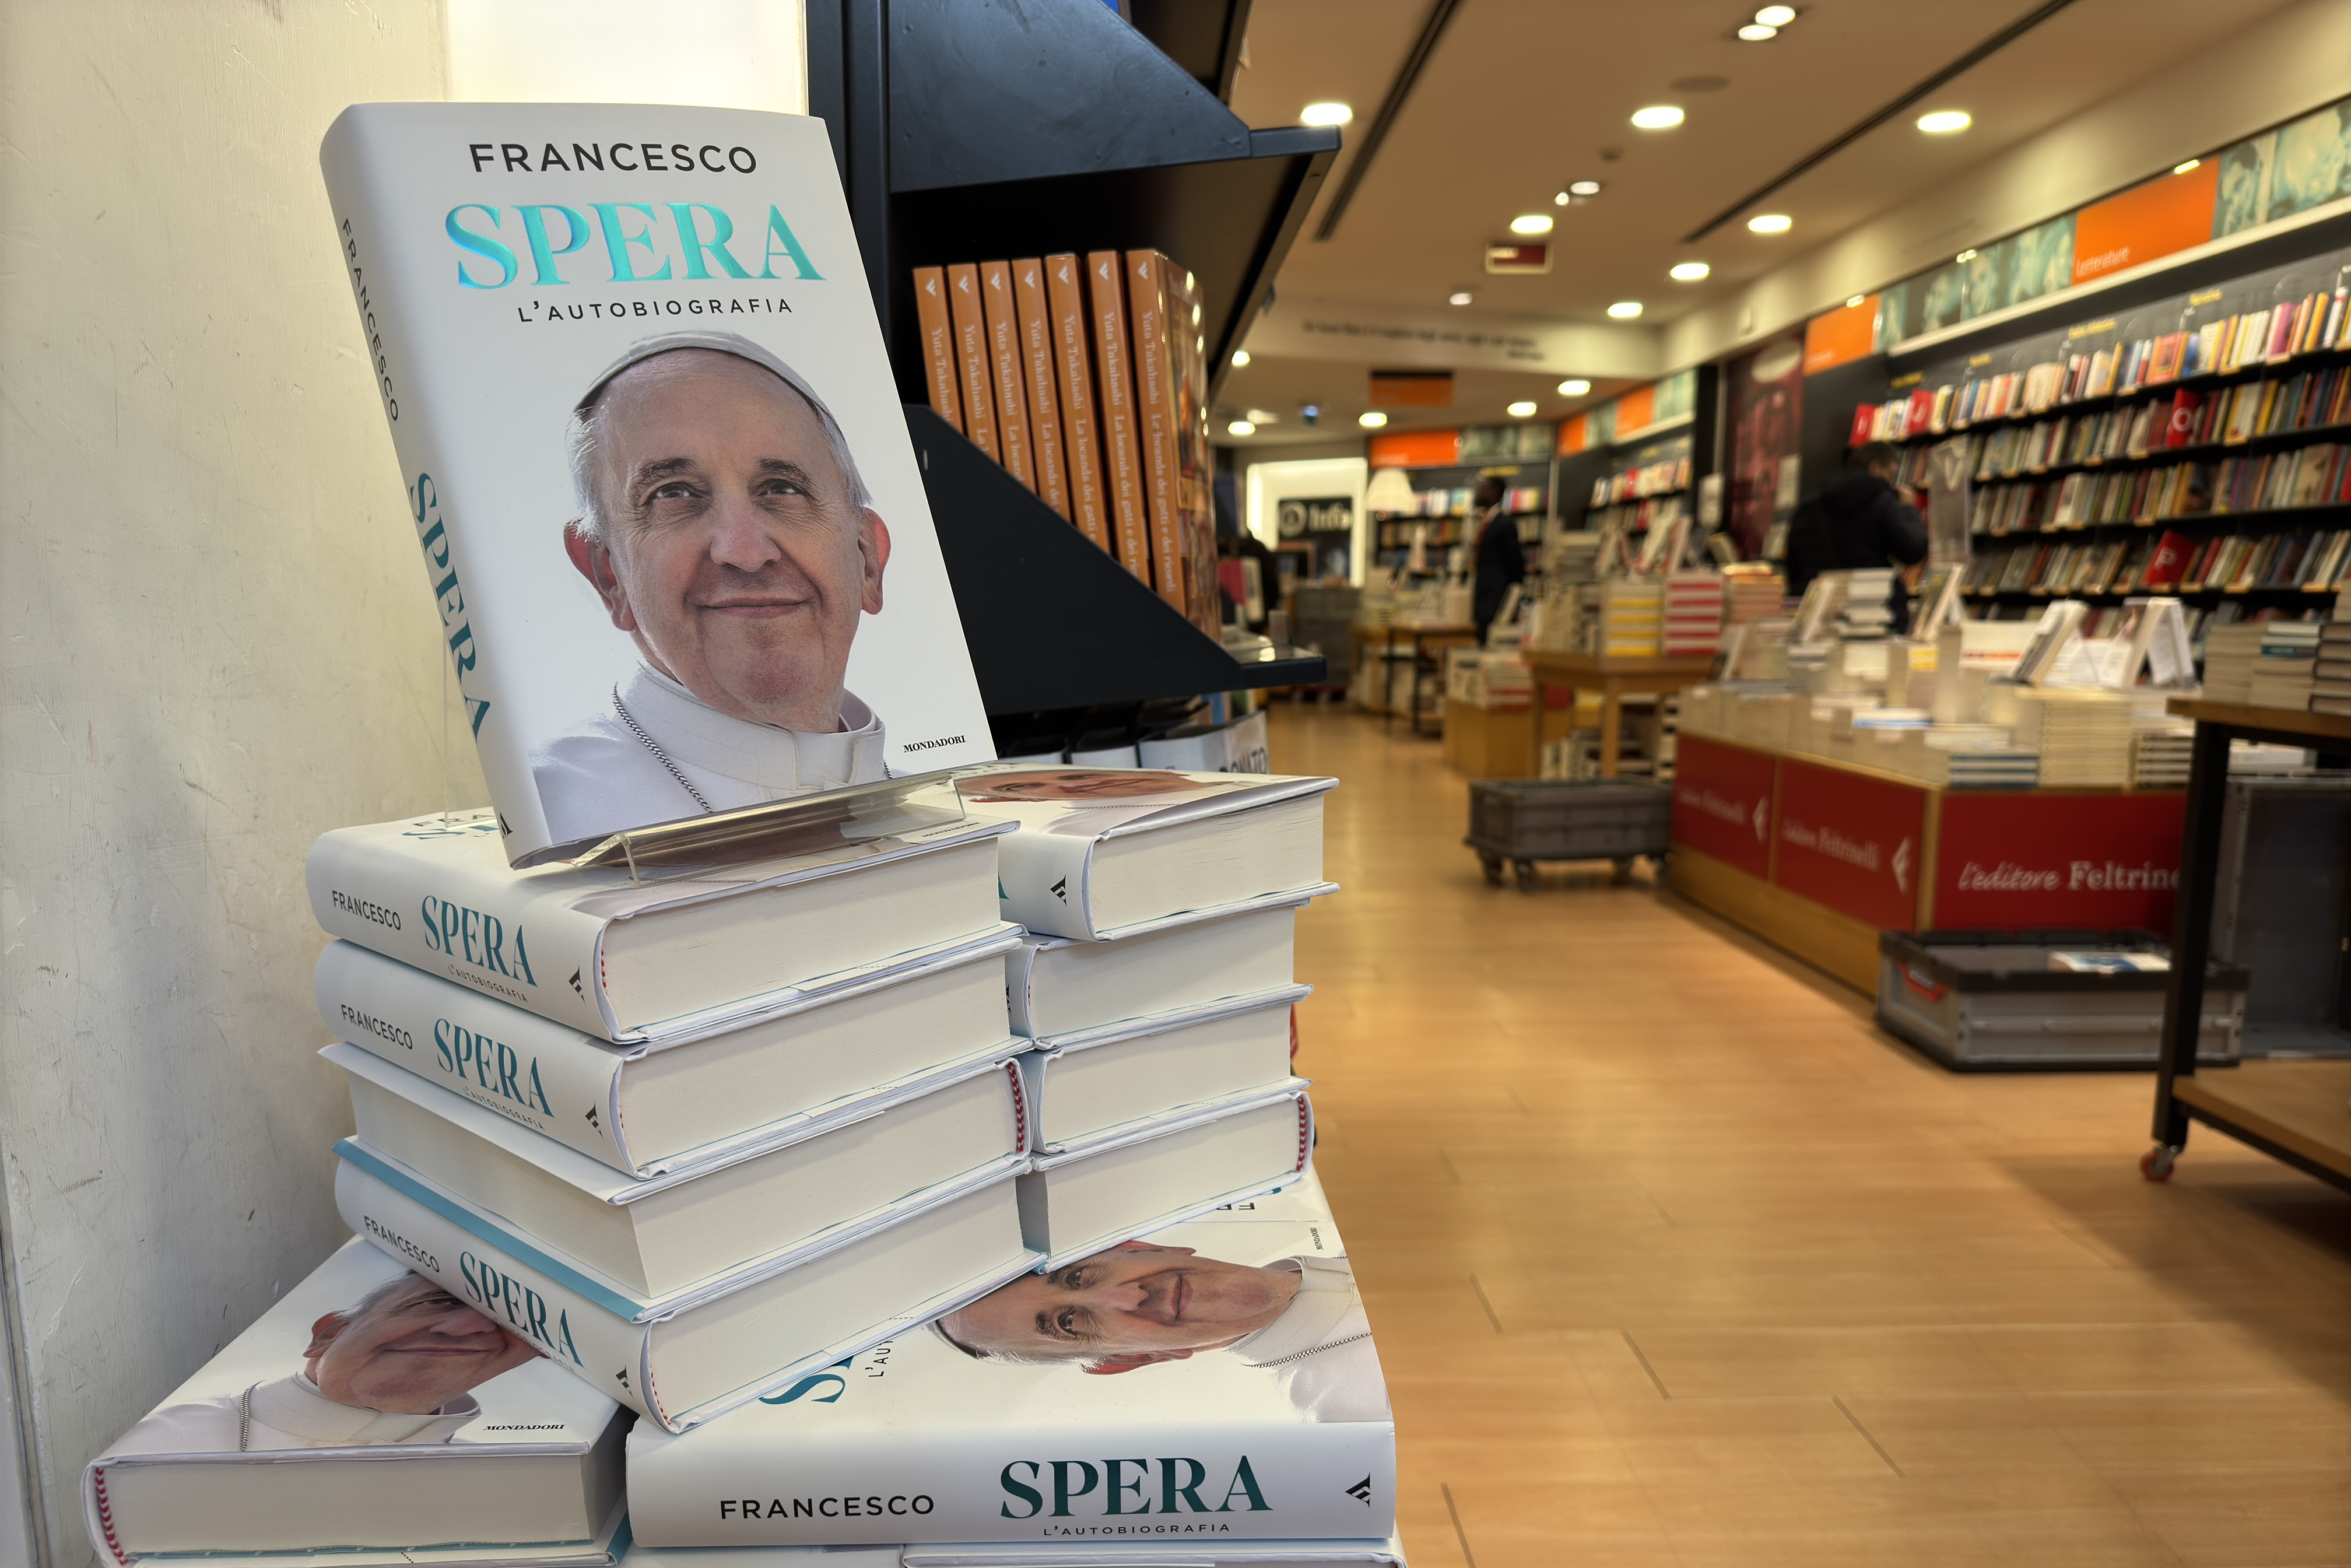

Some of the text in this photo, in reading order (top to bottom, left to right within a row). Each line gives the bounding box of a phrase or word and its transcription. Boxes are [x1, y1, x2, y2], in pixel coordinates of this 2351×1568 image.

[469, 143, 757, 174] FRANCESCO
[445, 202, 826, 289] SPERA
[343, 218, 398, 422] FRANCESCO
[518, 299, 792, 322] L'AUTOBIOGRAFIA
[1064, 314, 1075, 343] Yuta
[1103, 310, 1114, 340] Yuta
[1142, 310, 1153, 339] Yuta
[932, 327, 943, 356] Yuta
[964, 324, 976, 353] Yuta
[996, 321, 1007, 350] Yuta
[1030, 320, 1041, 348] Yuta
[968, 356, 985, 418] Takahashi
[999, 353, 1017, 416] Takahashi
[1033, 350, 1050, 414] Takahashi
[1068, 346, 1085, 410] Takahashi
[1107, 342, 1124, 406] Takahashi
[1145, 342, 1160, 405] Takahashi
[1012, 443, 1024, 481] locand
[410, 473, 490, 742] SPERA
[903, 735, 966, 753] MONDADORI
[1957, 860, 2180, 891] l'editore Feltrine
[332, 890, 401, 931] FRANCESCO
[422, 895, 539, 988] SPERA
[448, 964, 529, 1003] L'AUTOBIOGRAFIA
[341, 1004, 413, 1050] FRANCESCO
[434, 1018, 556, 1118] SPERA
[463, 1087, 545, 1131] L'AUTOBIOGRAFIA
[364, 1215, 440, 1273] FRANCESCO
[459, 1251, 587, 1369] SPERA
[720, 1495, 935, 1520] FRANCESCO
[1000, 1455, 1273, 1520] SPERA
[1043, 1523, 1231, 1537] L'AUTOBIOGRAFIA
